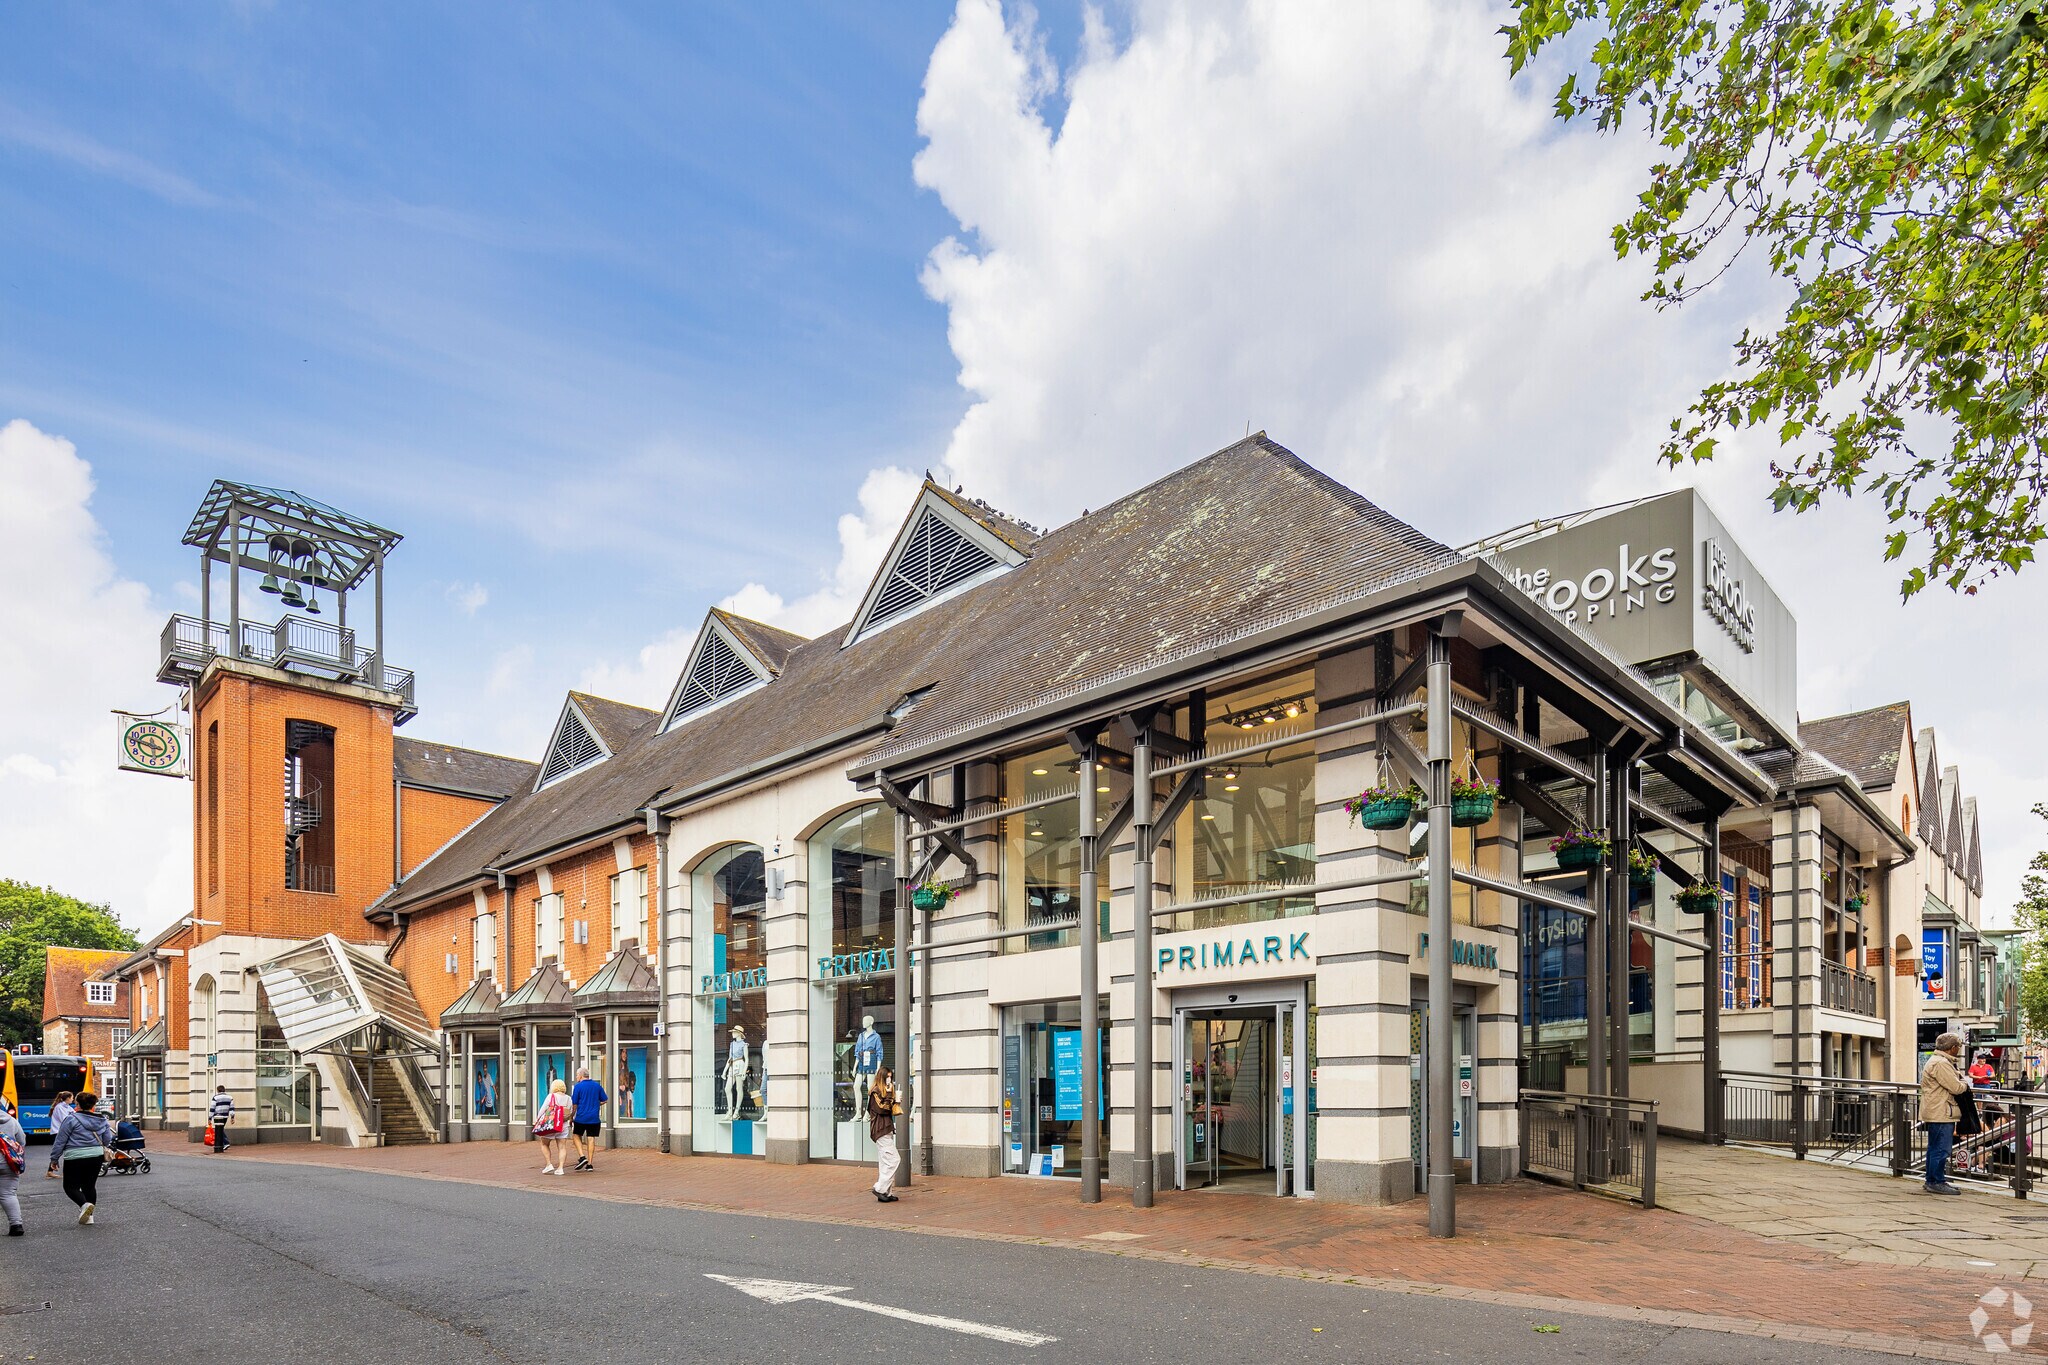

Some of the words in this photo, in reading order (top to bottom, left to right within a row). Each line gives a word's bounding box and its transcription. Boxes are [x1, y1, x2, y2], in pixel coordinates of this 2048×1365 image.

[1706, 538, 1755, 634] brooks
[1705, 590, 1755, 654] SHOPPING
[1158, 930, 1310, 973] PRIMARK
[1418, 932, 1499, 970] PMARK
[1924, 946, 1936, 954] The
[1924, 954, 1936, 963] Toy
[701, 967, 767, 994] PRIMAR
